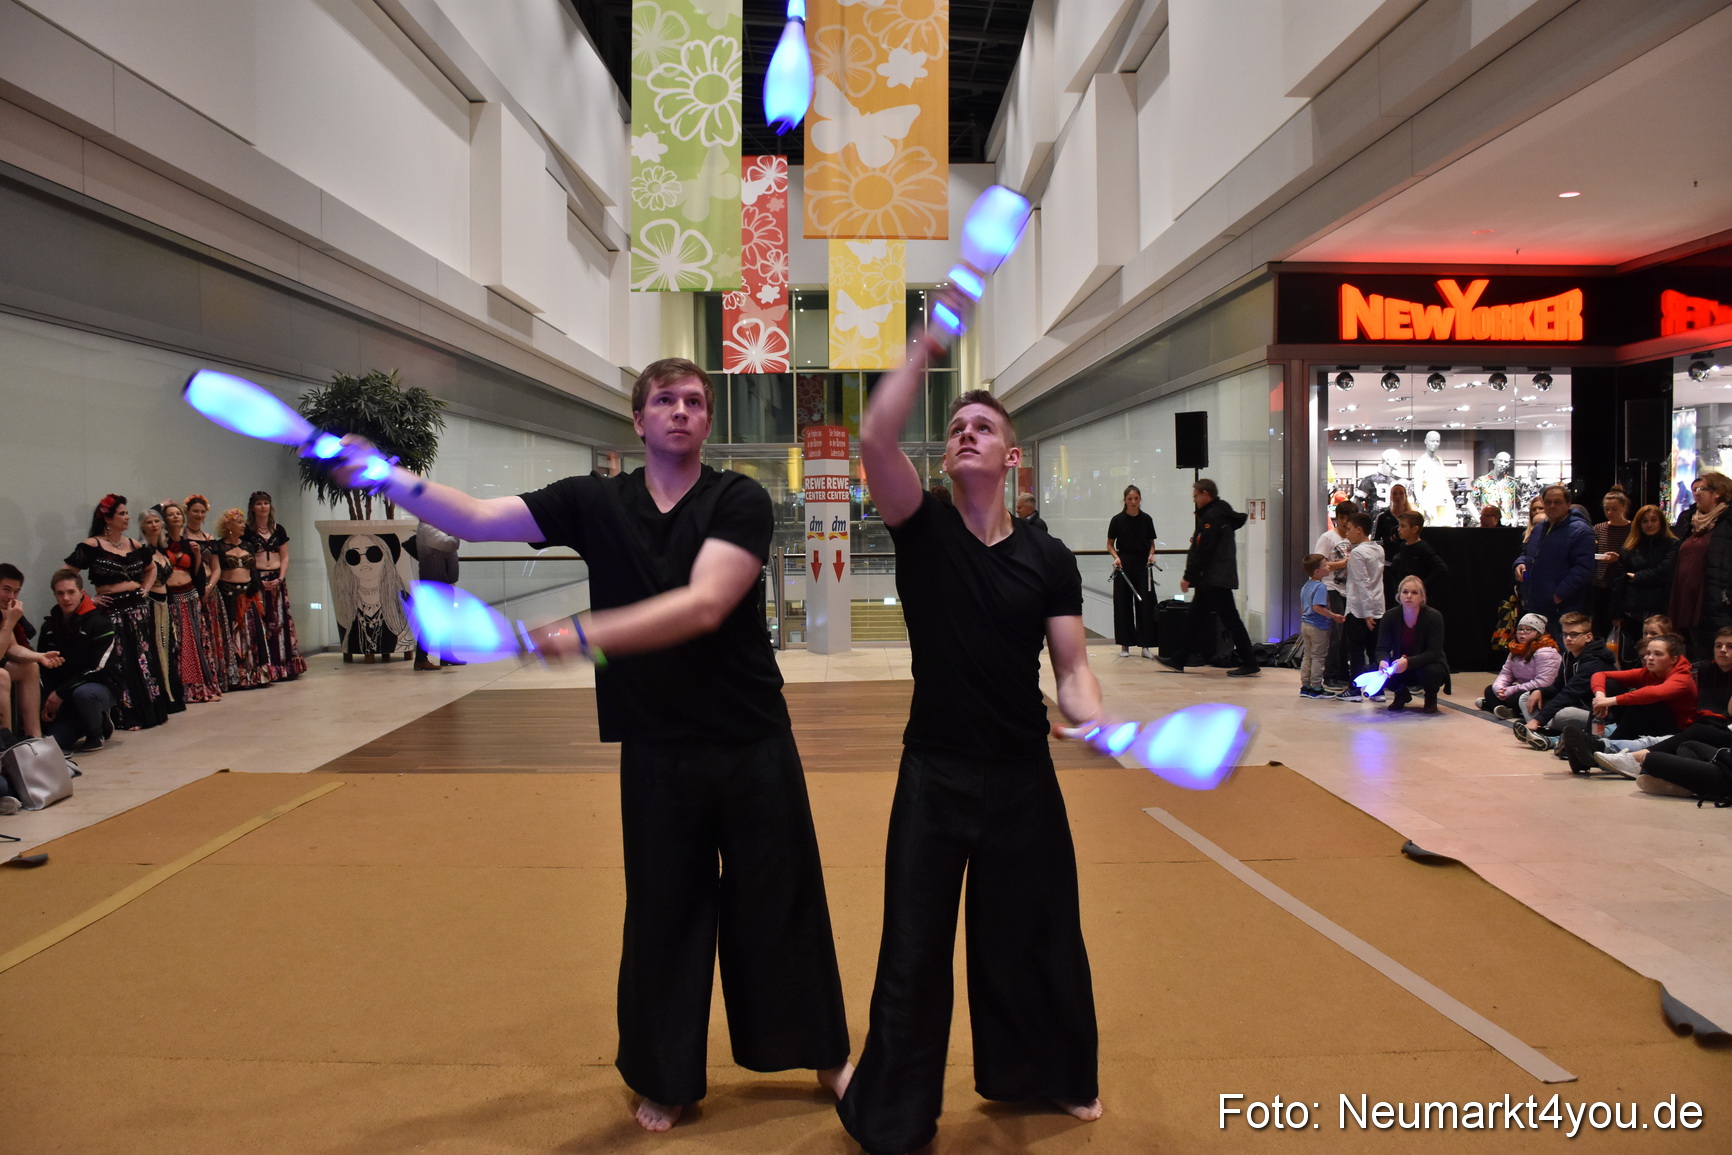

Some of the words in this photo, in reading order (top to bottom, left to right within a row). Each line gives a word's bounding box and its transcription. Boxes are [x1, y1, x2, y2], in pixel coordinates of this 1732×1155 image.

[805, 478, 825, 489] REWE
[827, 477, 849, 489] REWE
[805, 491, 826, 500] CENTER
[827, 491, 849, 500] CENTER
[810, 516, 823, 531] dm
[832, 516, 846, 531] dm
